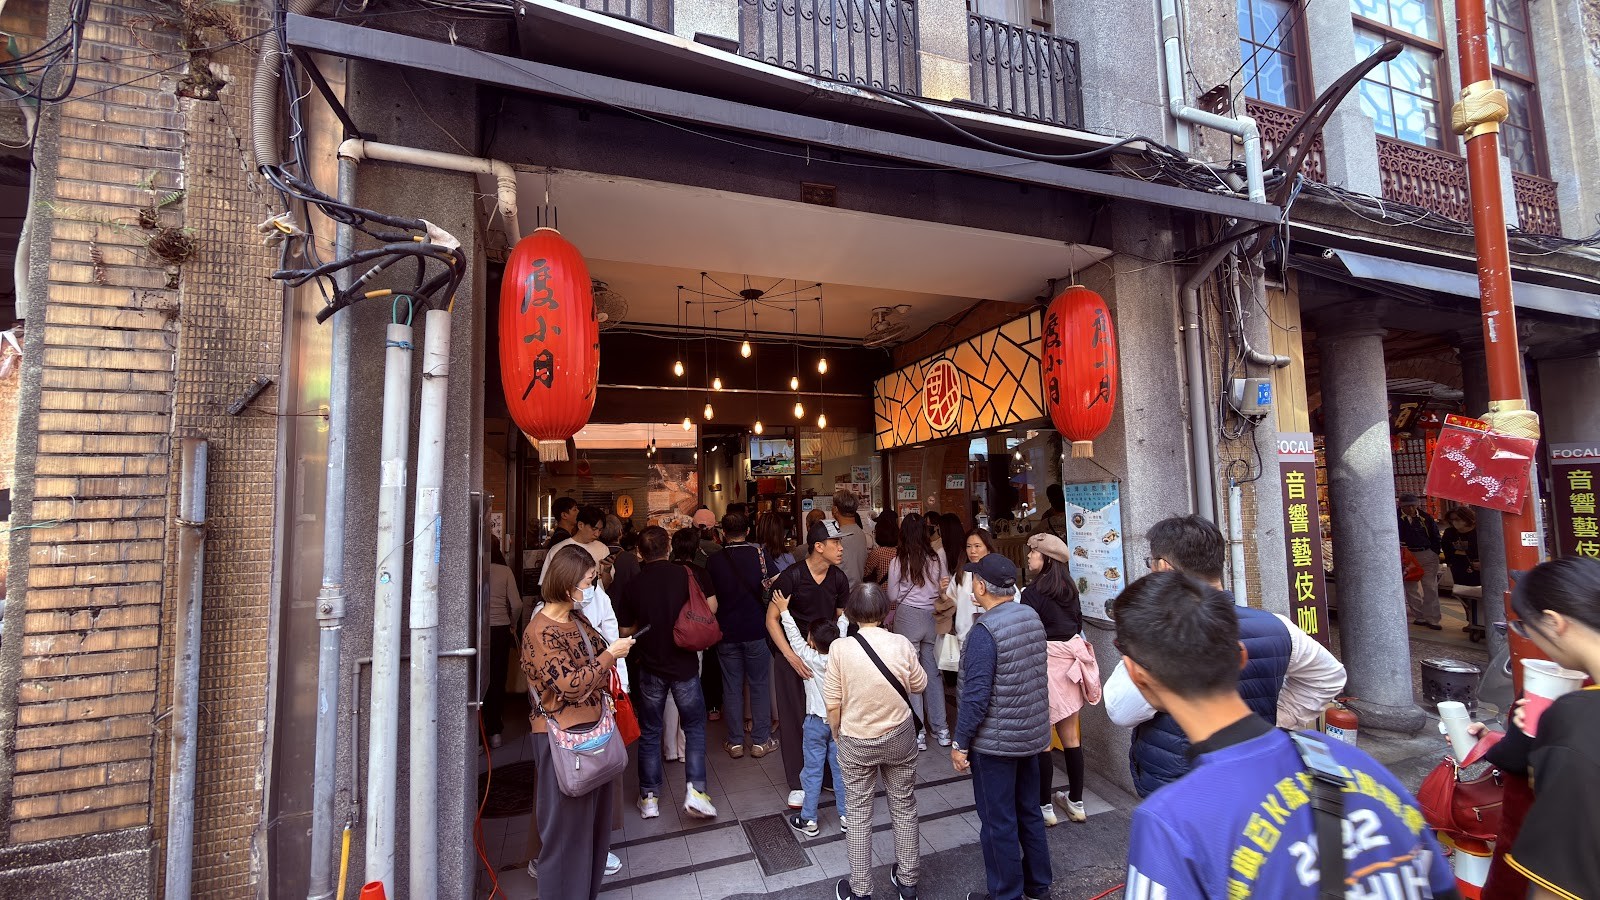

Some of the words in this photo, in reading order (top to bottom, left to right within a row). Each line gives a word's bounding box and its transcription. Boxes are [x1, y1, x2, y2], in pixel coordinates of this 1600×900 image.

[521, 258, 561, 400] 度小月
[1043, 312, 1063, 405] 度小月
[1277, 440, 1312, 453] OCAL
[1286, 470, 1318, 634] 音響藝伎咖
